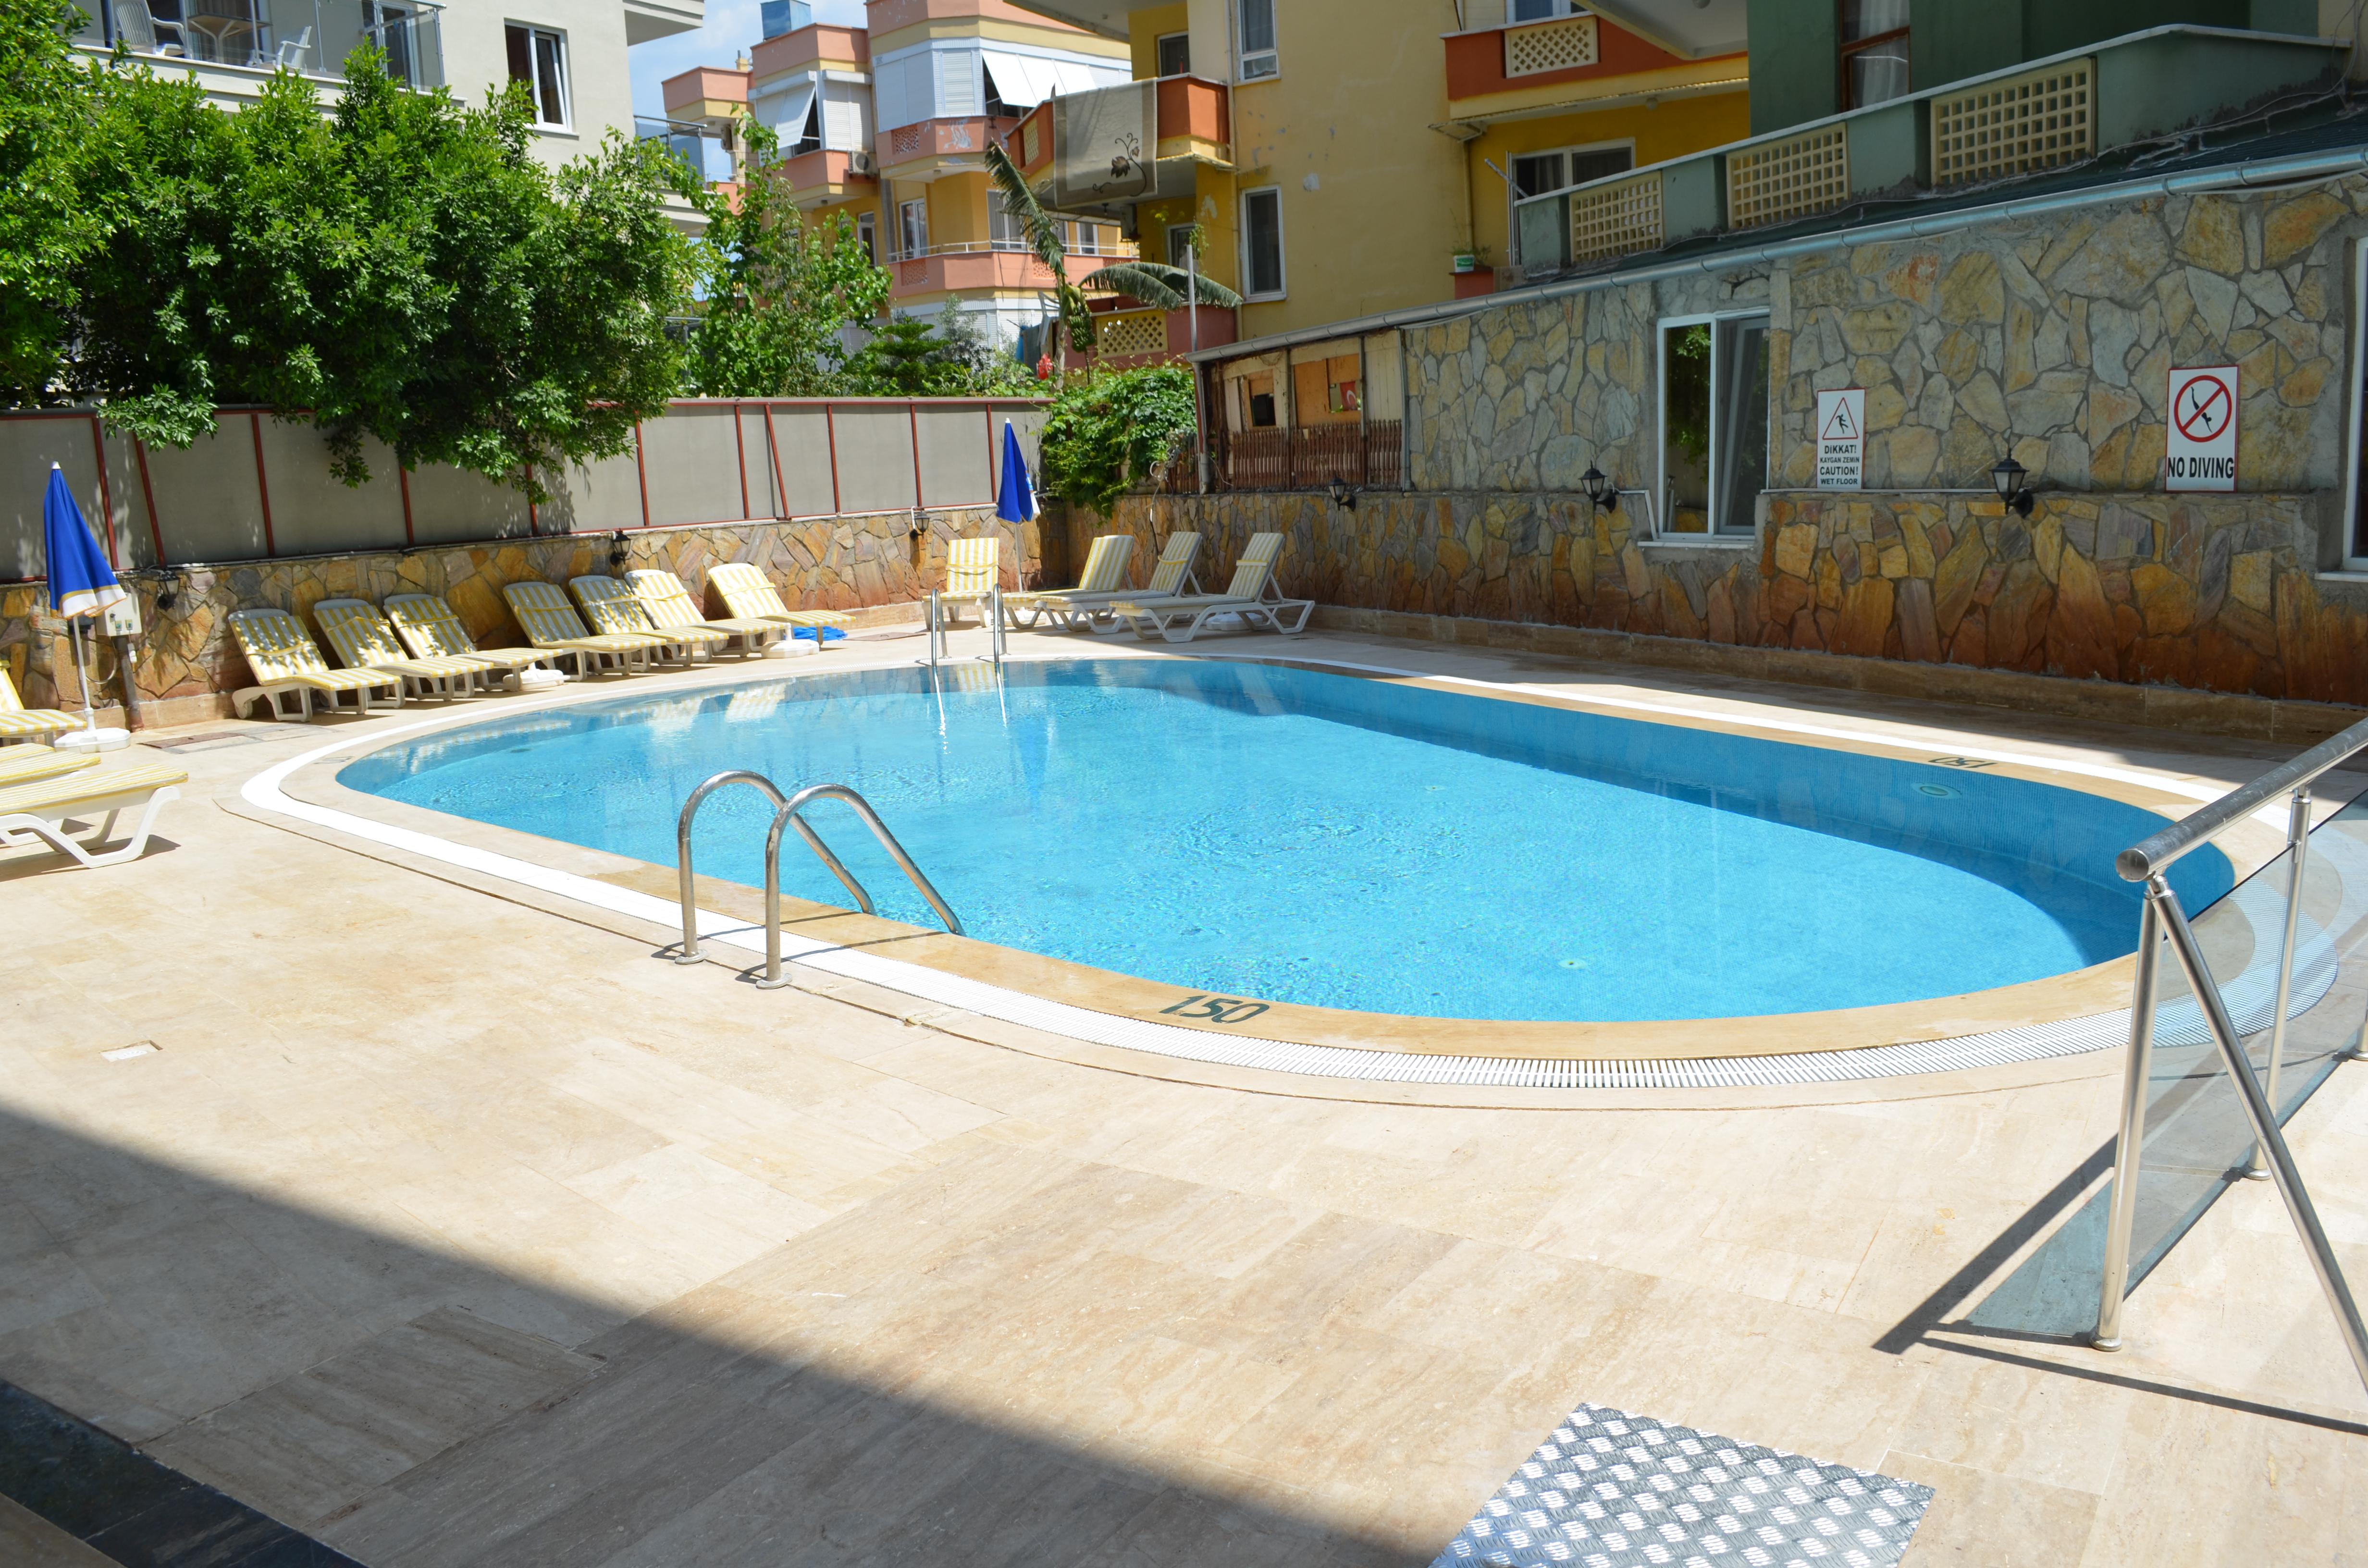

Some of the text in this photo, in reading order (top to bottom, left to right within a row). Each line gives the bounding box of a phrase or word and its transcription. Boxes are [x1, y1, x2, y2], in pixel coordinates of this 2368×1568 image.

[1820, 466, 1858, 475] CAUTION!
[2167, 457, 2234, 478] NO DIVING
[1928, 757, 1998, 768] 150
[1158, 995, 1270, 1024] 150
